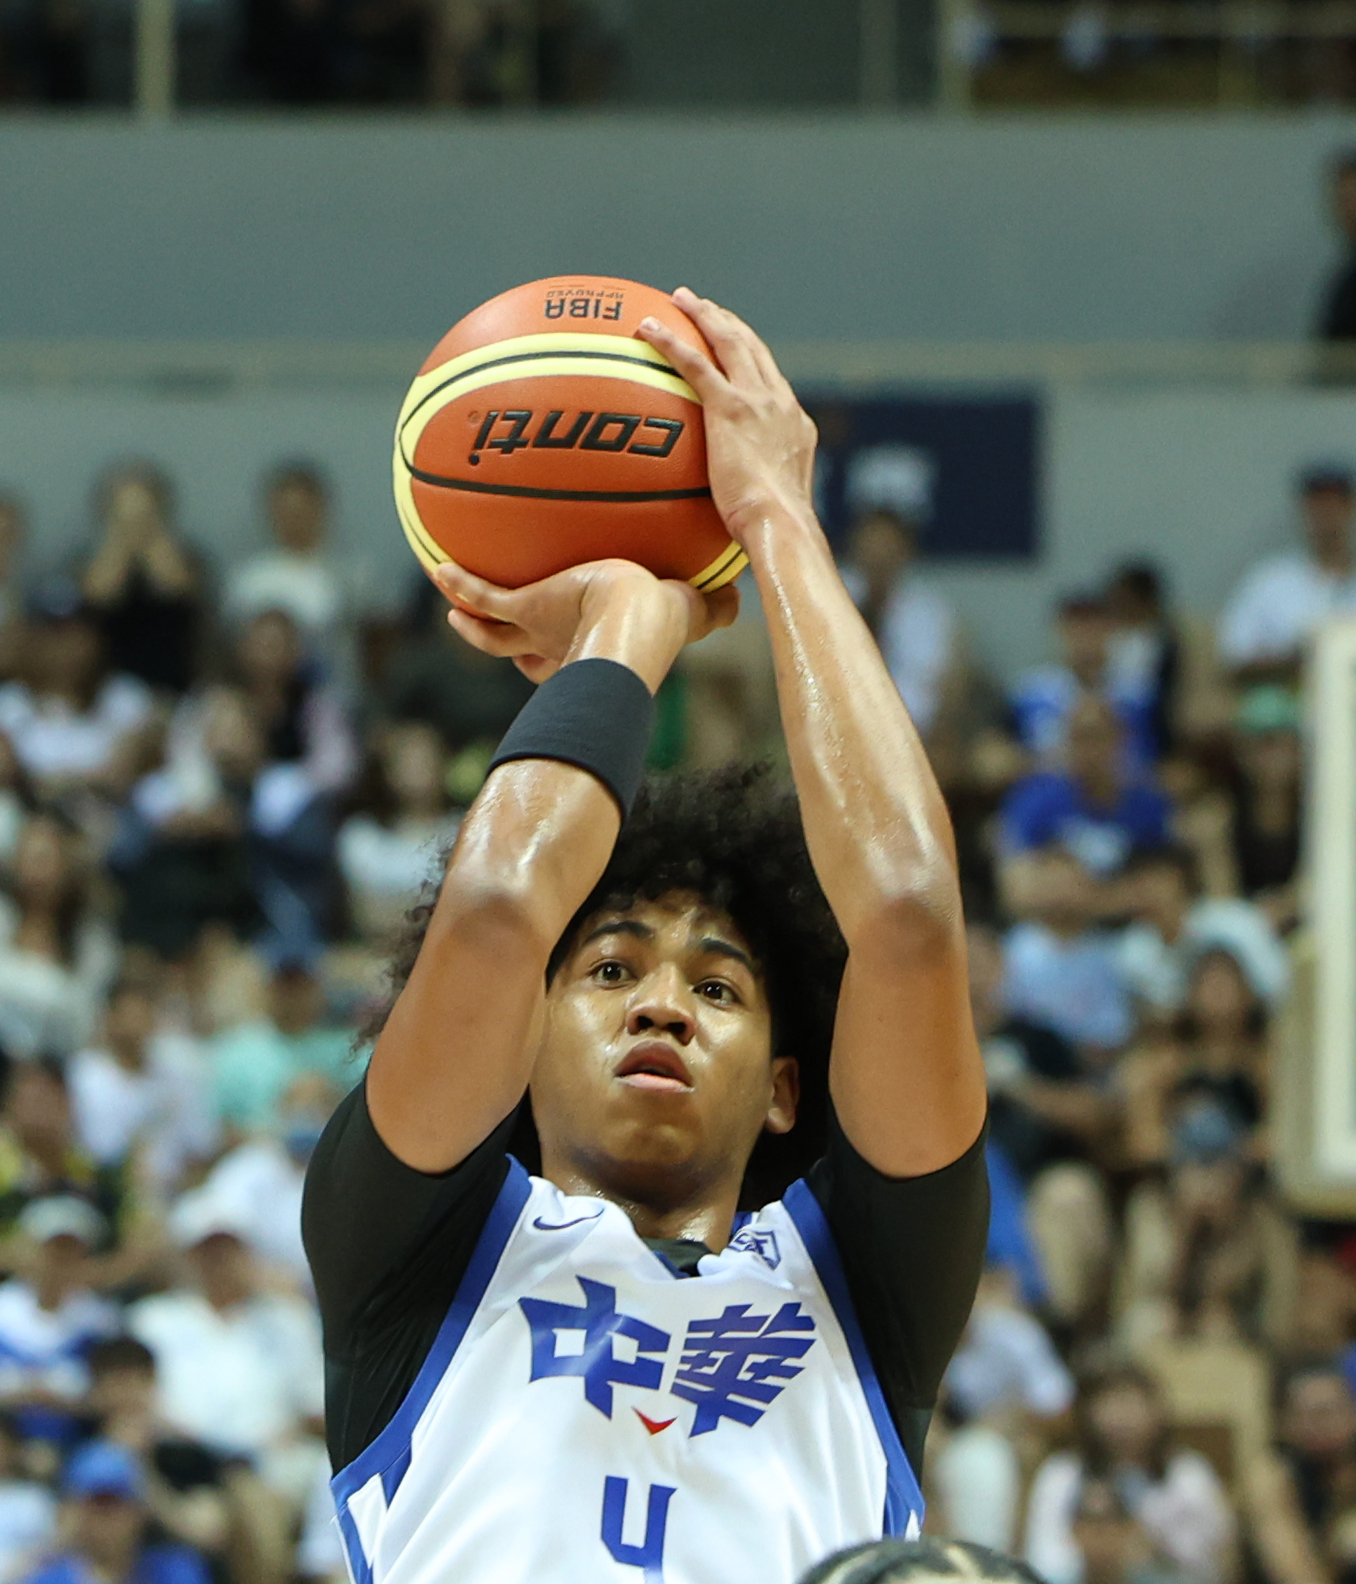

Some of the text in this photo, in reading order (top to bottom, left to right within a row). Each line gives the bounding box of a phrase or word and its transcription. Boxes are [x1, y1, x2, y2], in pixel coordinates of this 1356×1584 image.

[545, 298, 623, 321] FIBA
[468, 409, 686, 466] conti
[518, 1275, 818, 1438] 中華
